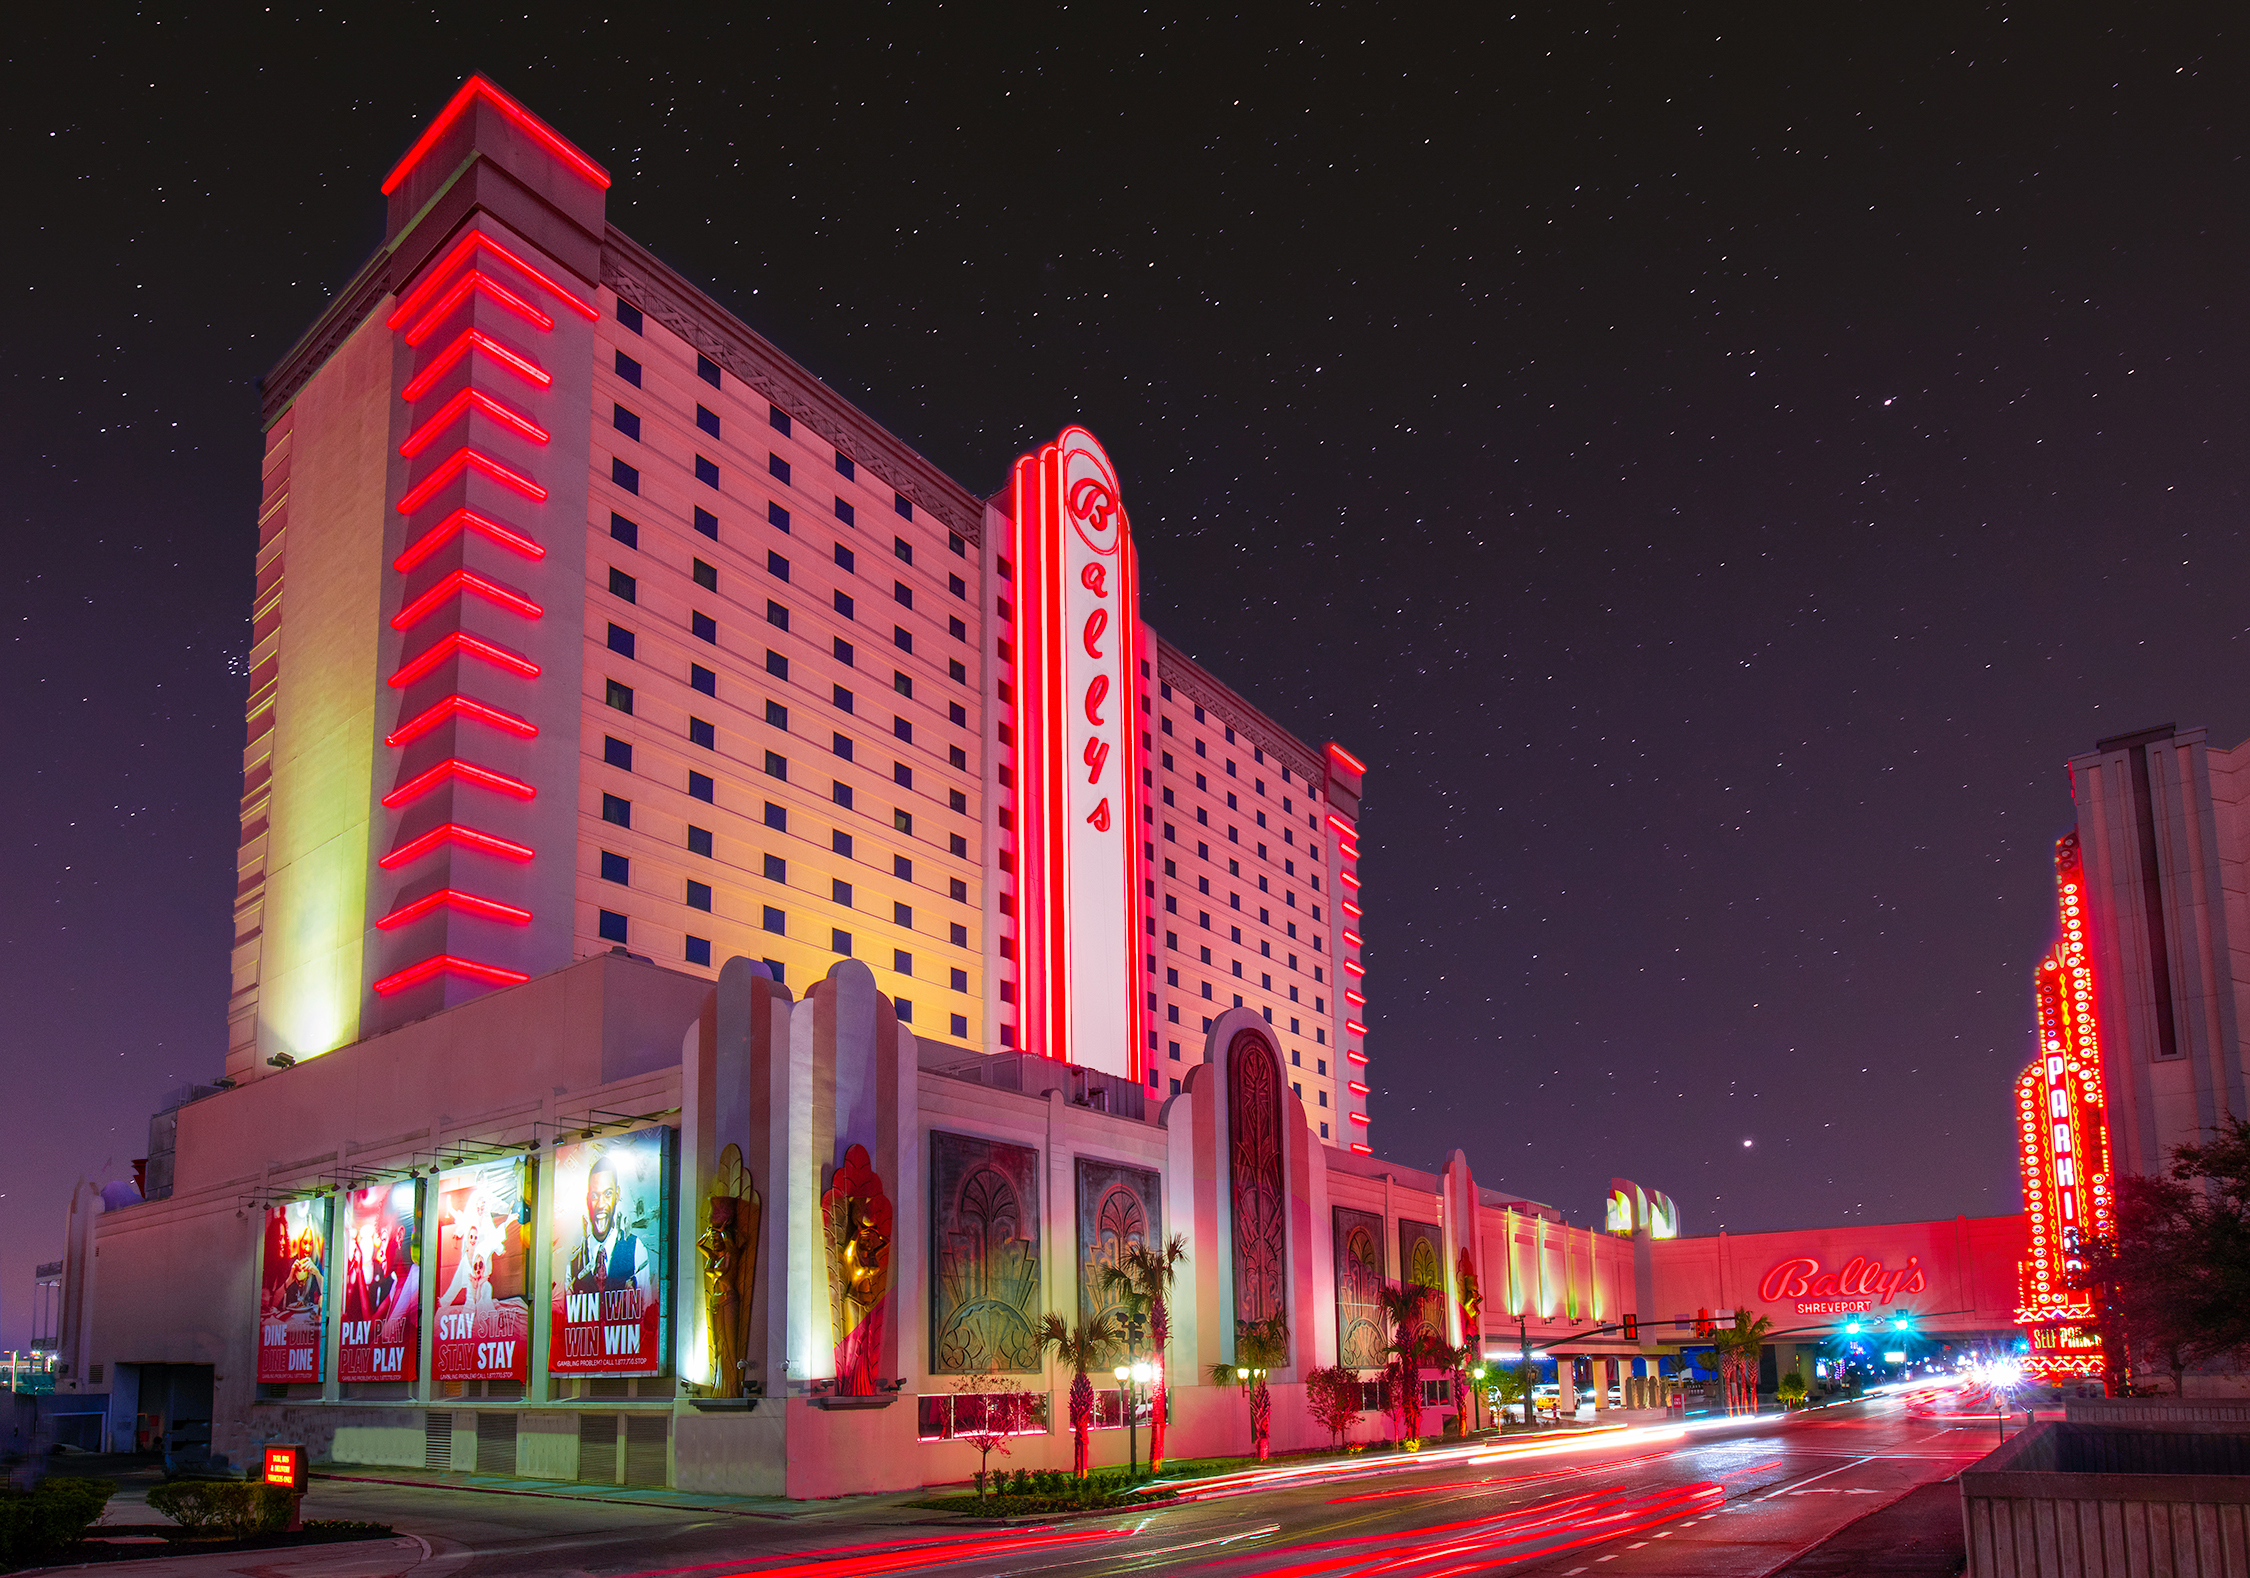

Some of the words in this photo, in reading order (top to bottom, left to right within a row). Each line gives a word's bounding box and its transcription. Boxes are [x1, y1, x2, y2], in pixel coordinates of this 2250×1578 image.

[1760, 1255, 1927, 1305] Bally's
[566, 1292, 600, 1323] WIN
[604, 1288, 641, 1321] WIN
[1797, 1301, 1872, 1313] SHREVEPORT
[264, 1324, 287, 1346] DINE
[290, 1323, 315, 1346] DINE
[342, 1320, 371, 1345] PLAY
[373, 1317, 406, 1344] PLAY
[440, 1313, 475, 1340] STAY
[478, 1308, 518, 1339] STAY
[565, 1326, 599, 1357] WIN
[604, 1324, 640, 1355] WIN
[2034, 1328, 2056, 1349] SELF
[262, 1349, 287, 1371] DINE
[288, 1348, 314, 1370] DINE
[341, 1348, 370, 1373] PLAY
[373, 1347, 405, 1372] PLAY
[438, 1343, 475, 1371] STAY
[477, 1341, 515, 1369] STAY
